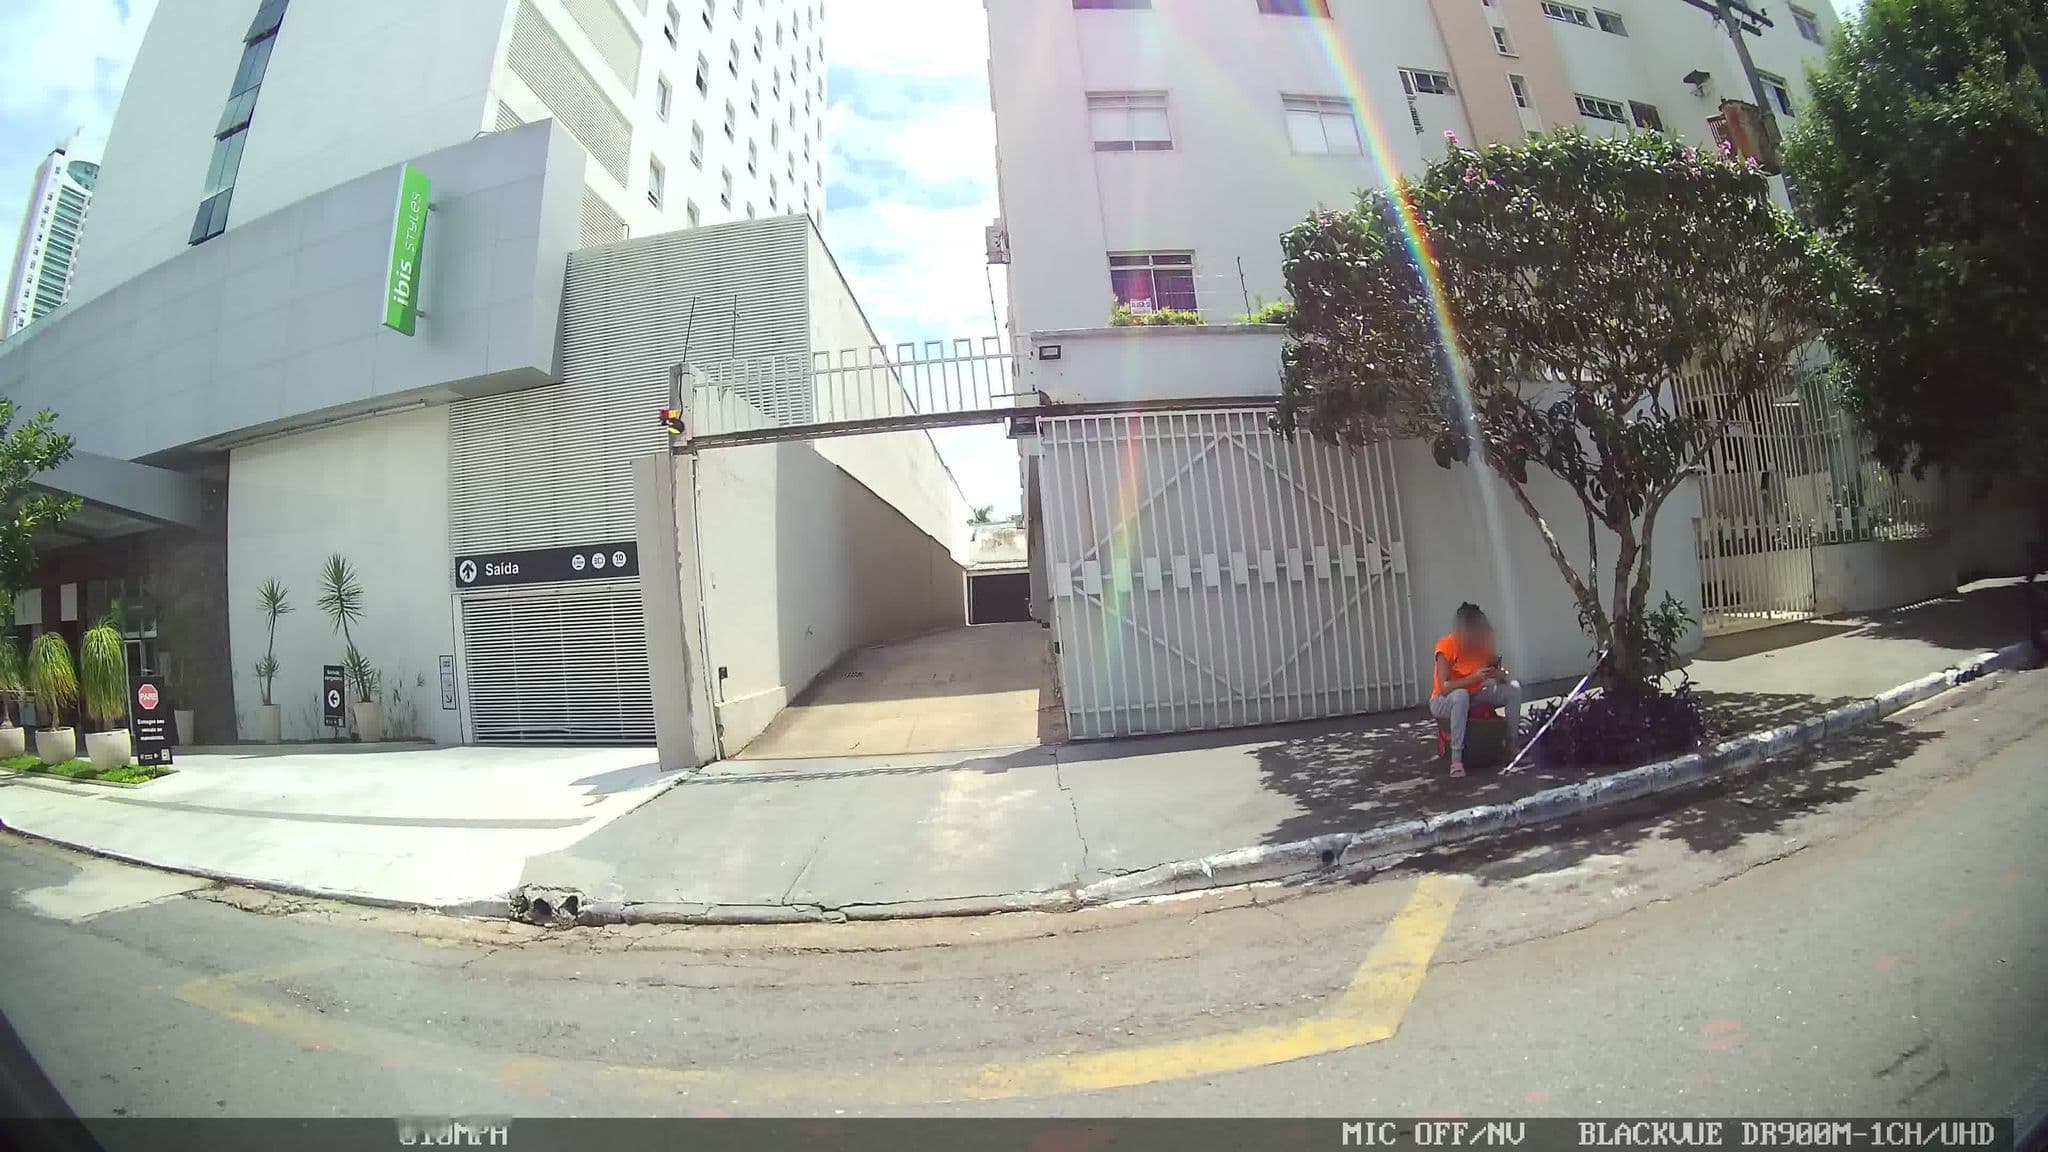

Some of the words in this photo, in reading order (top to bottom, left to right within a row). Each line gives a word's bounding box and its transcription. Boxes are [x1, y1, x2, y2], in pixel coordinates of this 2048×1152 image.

[393, 259, 412, 307] ibis
[614, 552, 624, 563] 10
[485, 561, 520, 577] Saída
